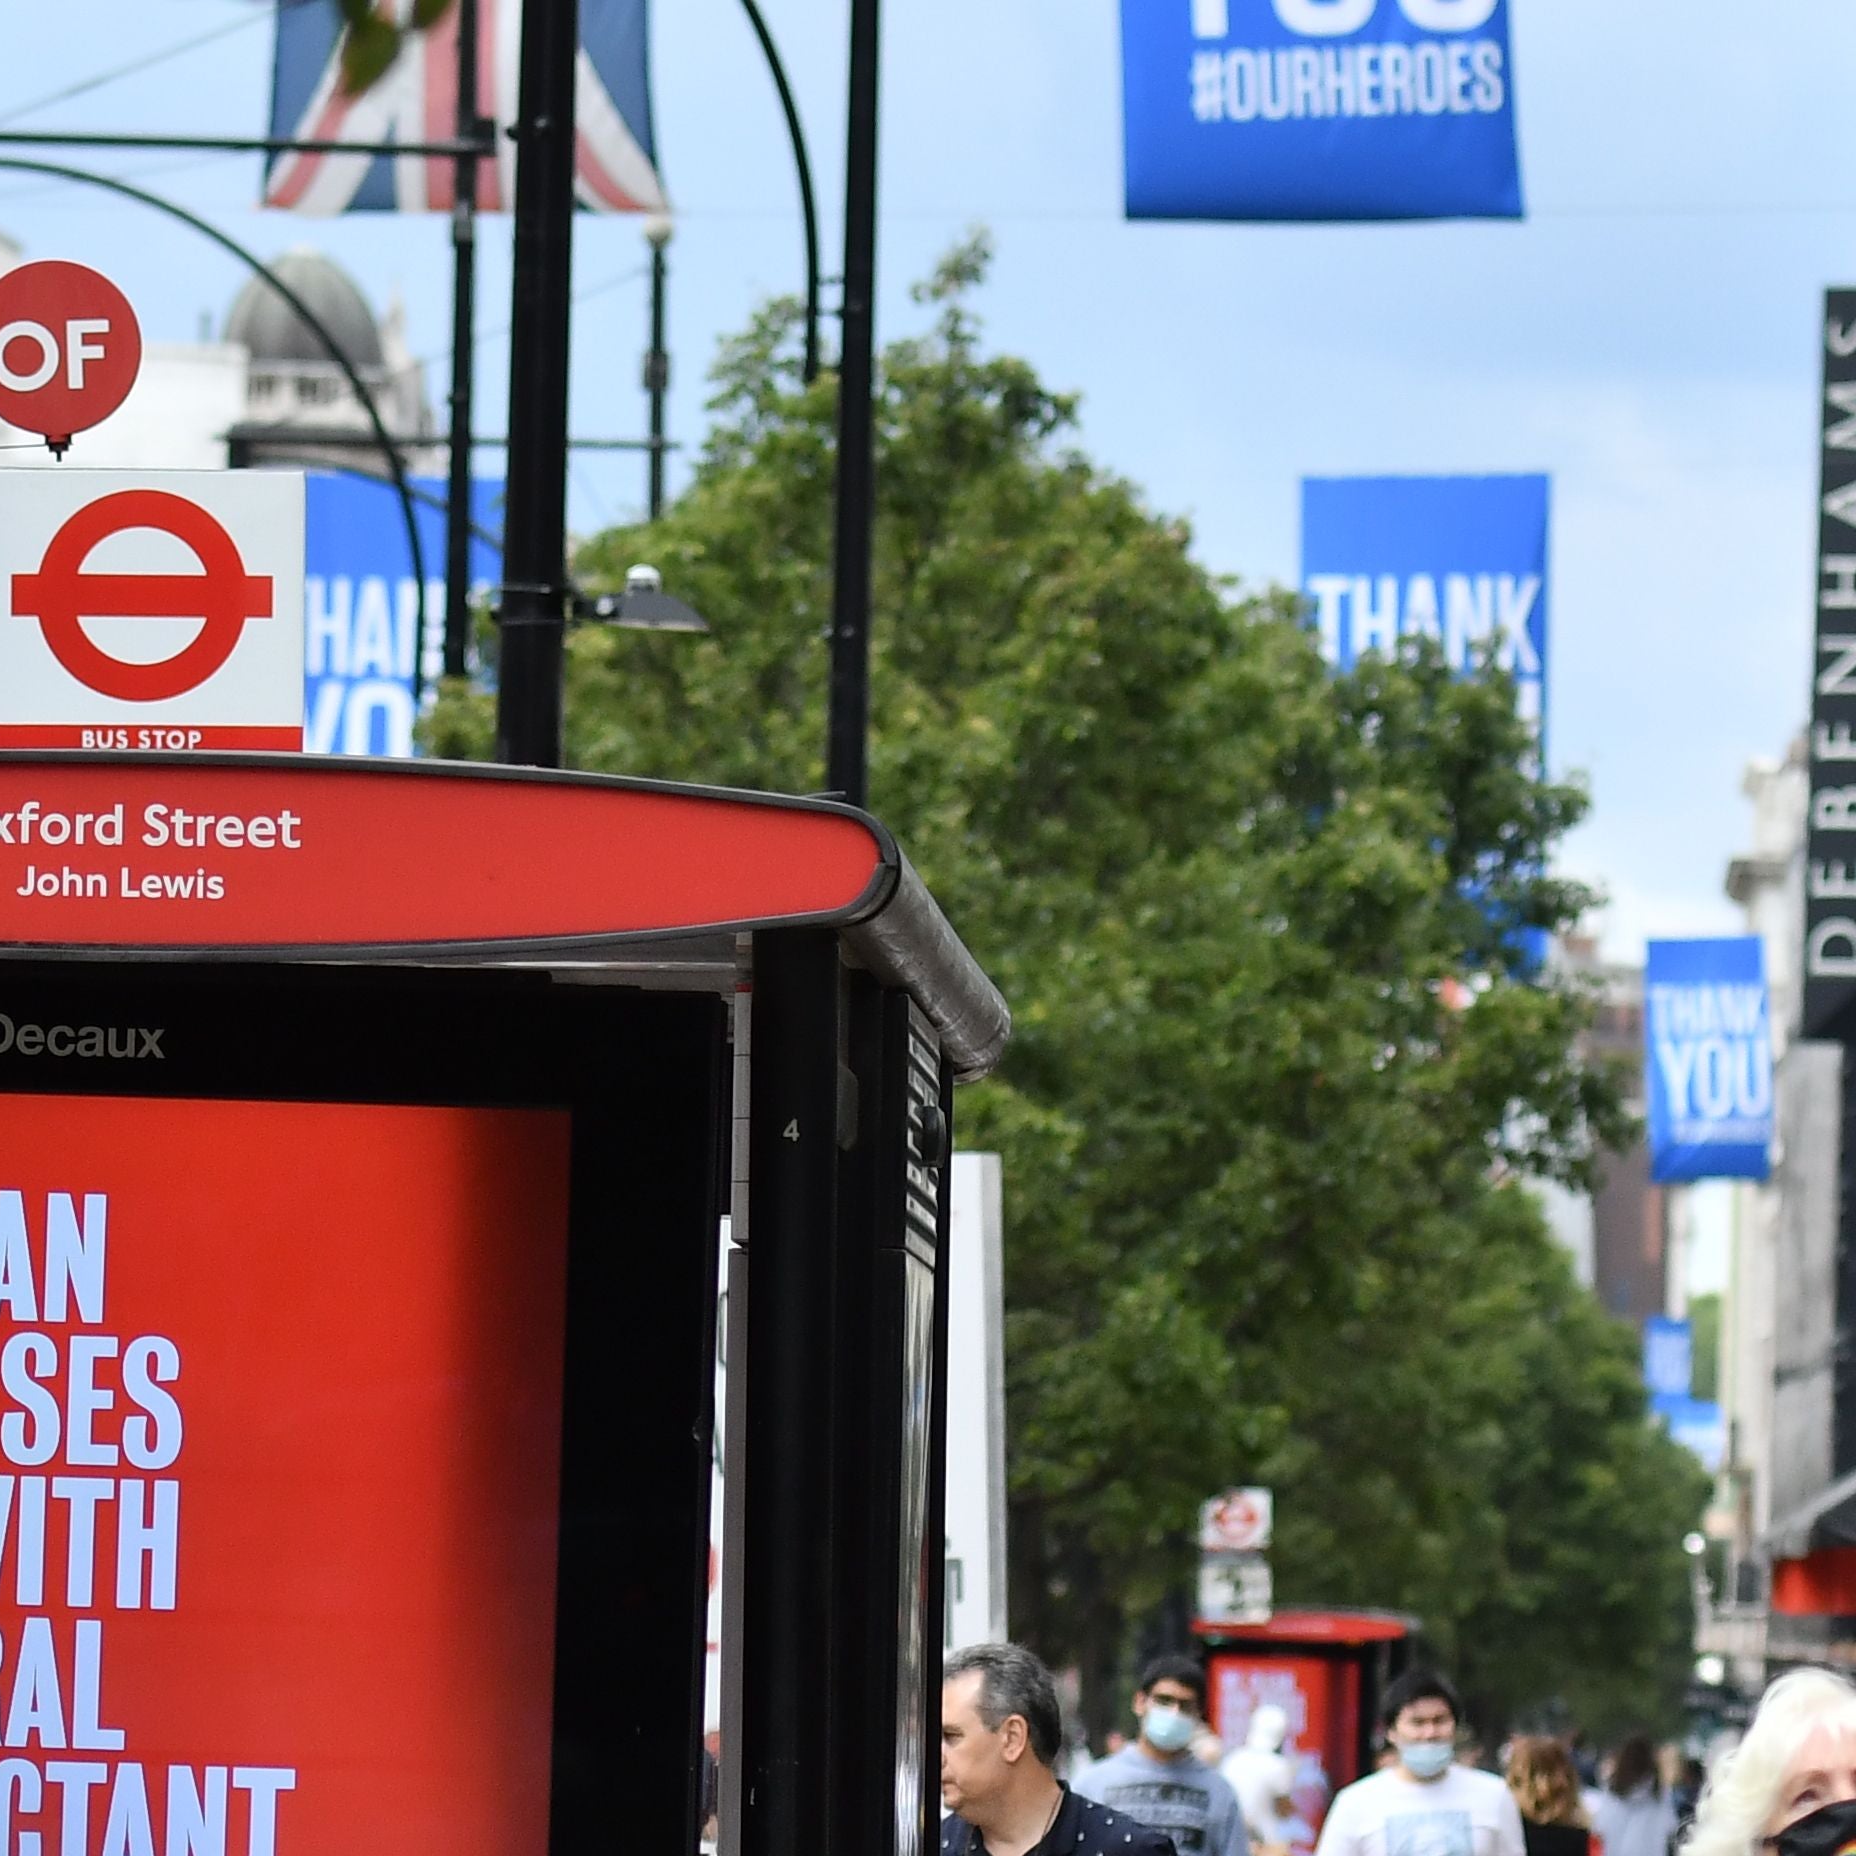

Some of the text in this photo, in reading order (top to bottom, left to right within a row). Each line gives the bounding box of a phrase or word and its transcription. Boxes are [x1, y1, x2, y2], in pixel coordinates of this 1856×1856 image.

[1190, 39, 1505, 122] #OURHEROES
[1306, 573, 1542, 673] THANK
[81, 730, 202, 750] BUS STOP
[143, 804, 300, 848] Street
[17, 866, 224, 899] John Lewis
[1657, 1038, 1768, 1119] YOU
[783, 1119, 799, 1141] 4
